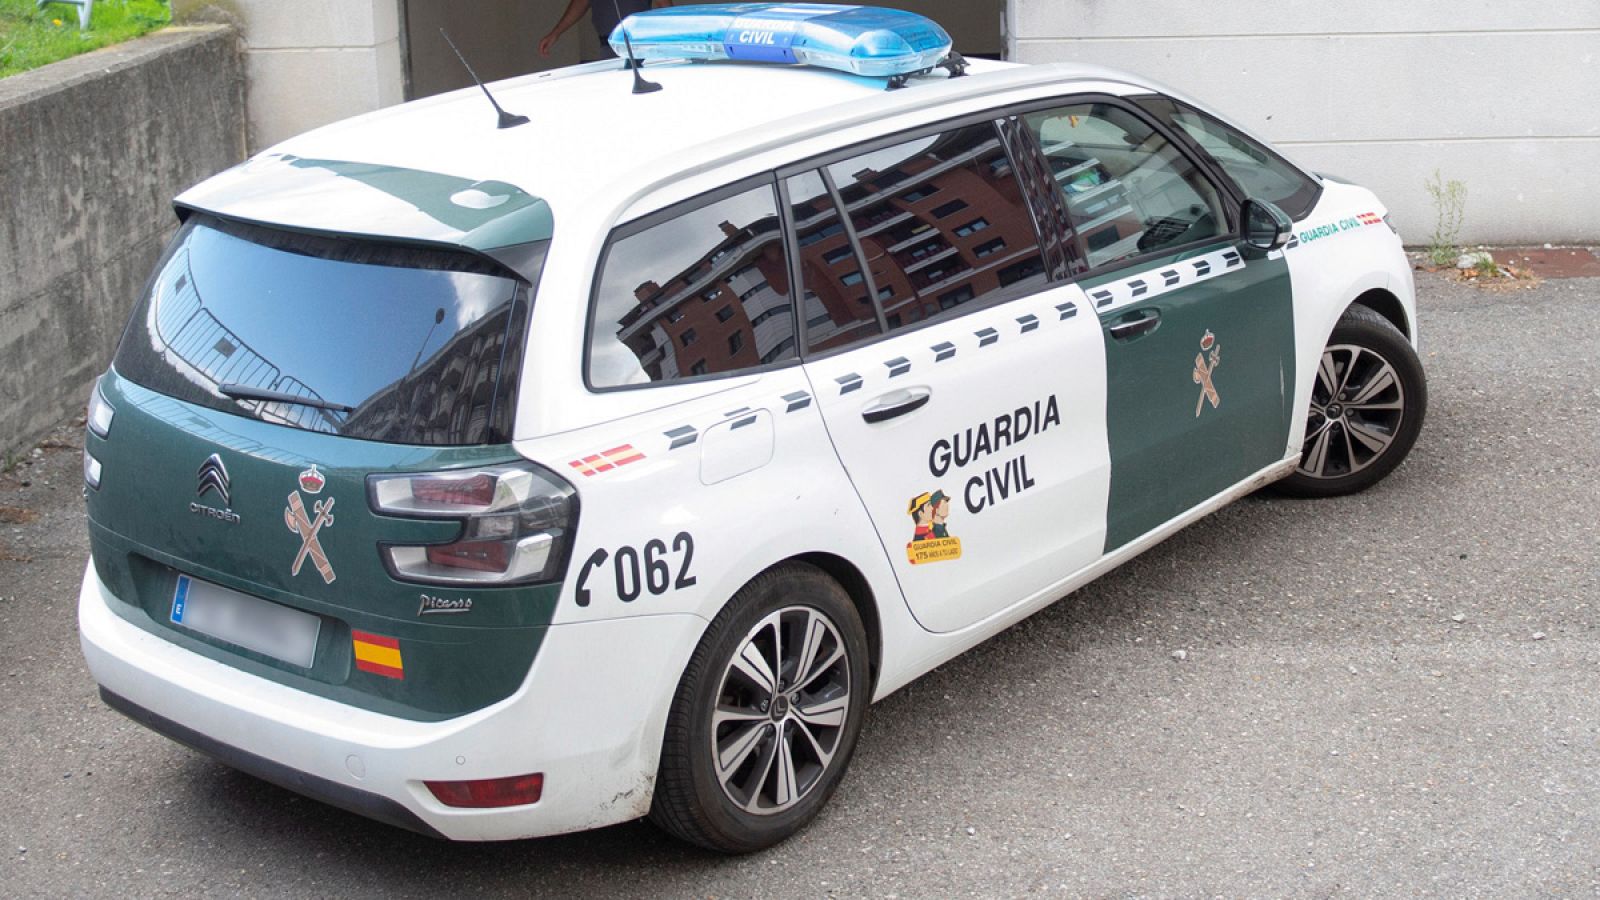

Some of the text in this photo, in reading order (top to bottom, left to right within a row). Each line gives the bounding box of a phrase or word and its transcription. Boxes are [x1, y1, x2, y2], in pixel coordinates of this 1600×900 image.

[739, 31, 775, 45] CIVIL
[1299, 216, 1361, 244] GUARDIA CIVIL
[928, 394, 1061, 478] GUARDIA
[963, 455, 1036, 514] CIVIL
[614, 531, 697, 603] 062
[175, 603, 183, 615] E
[416, 594, 473, 617] Picasso
